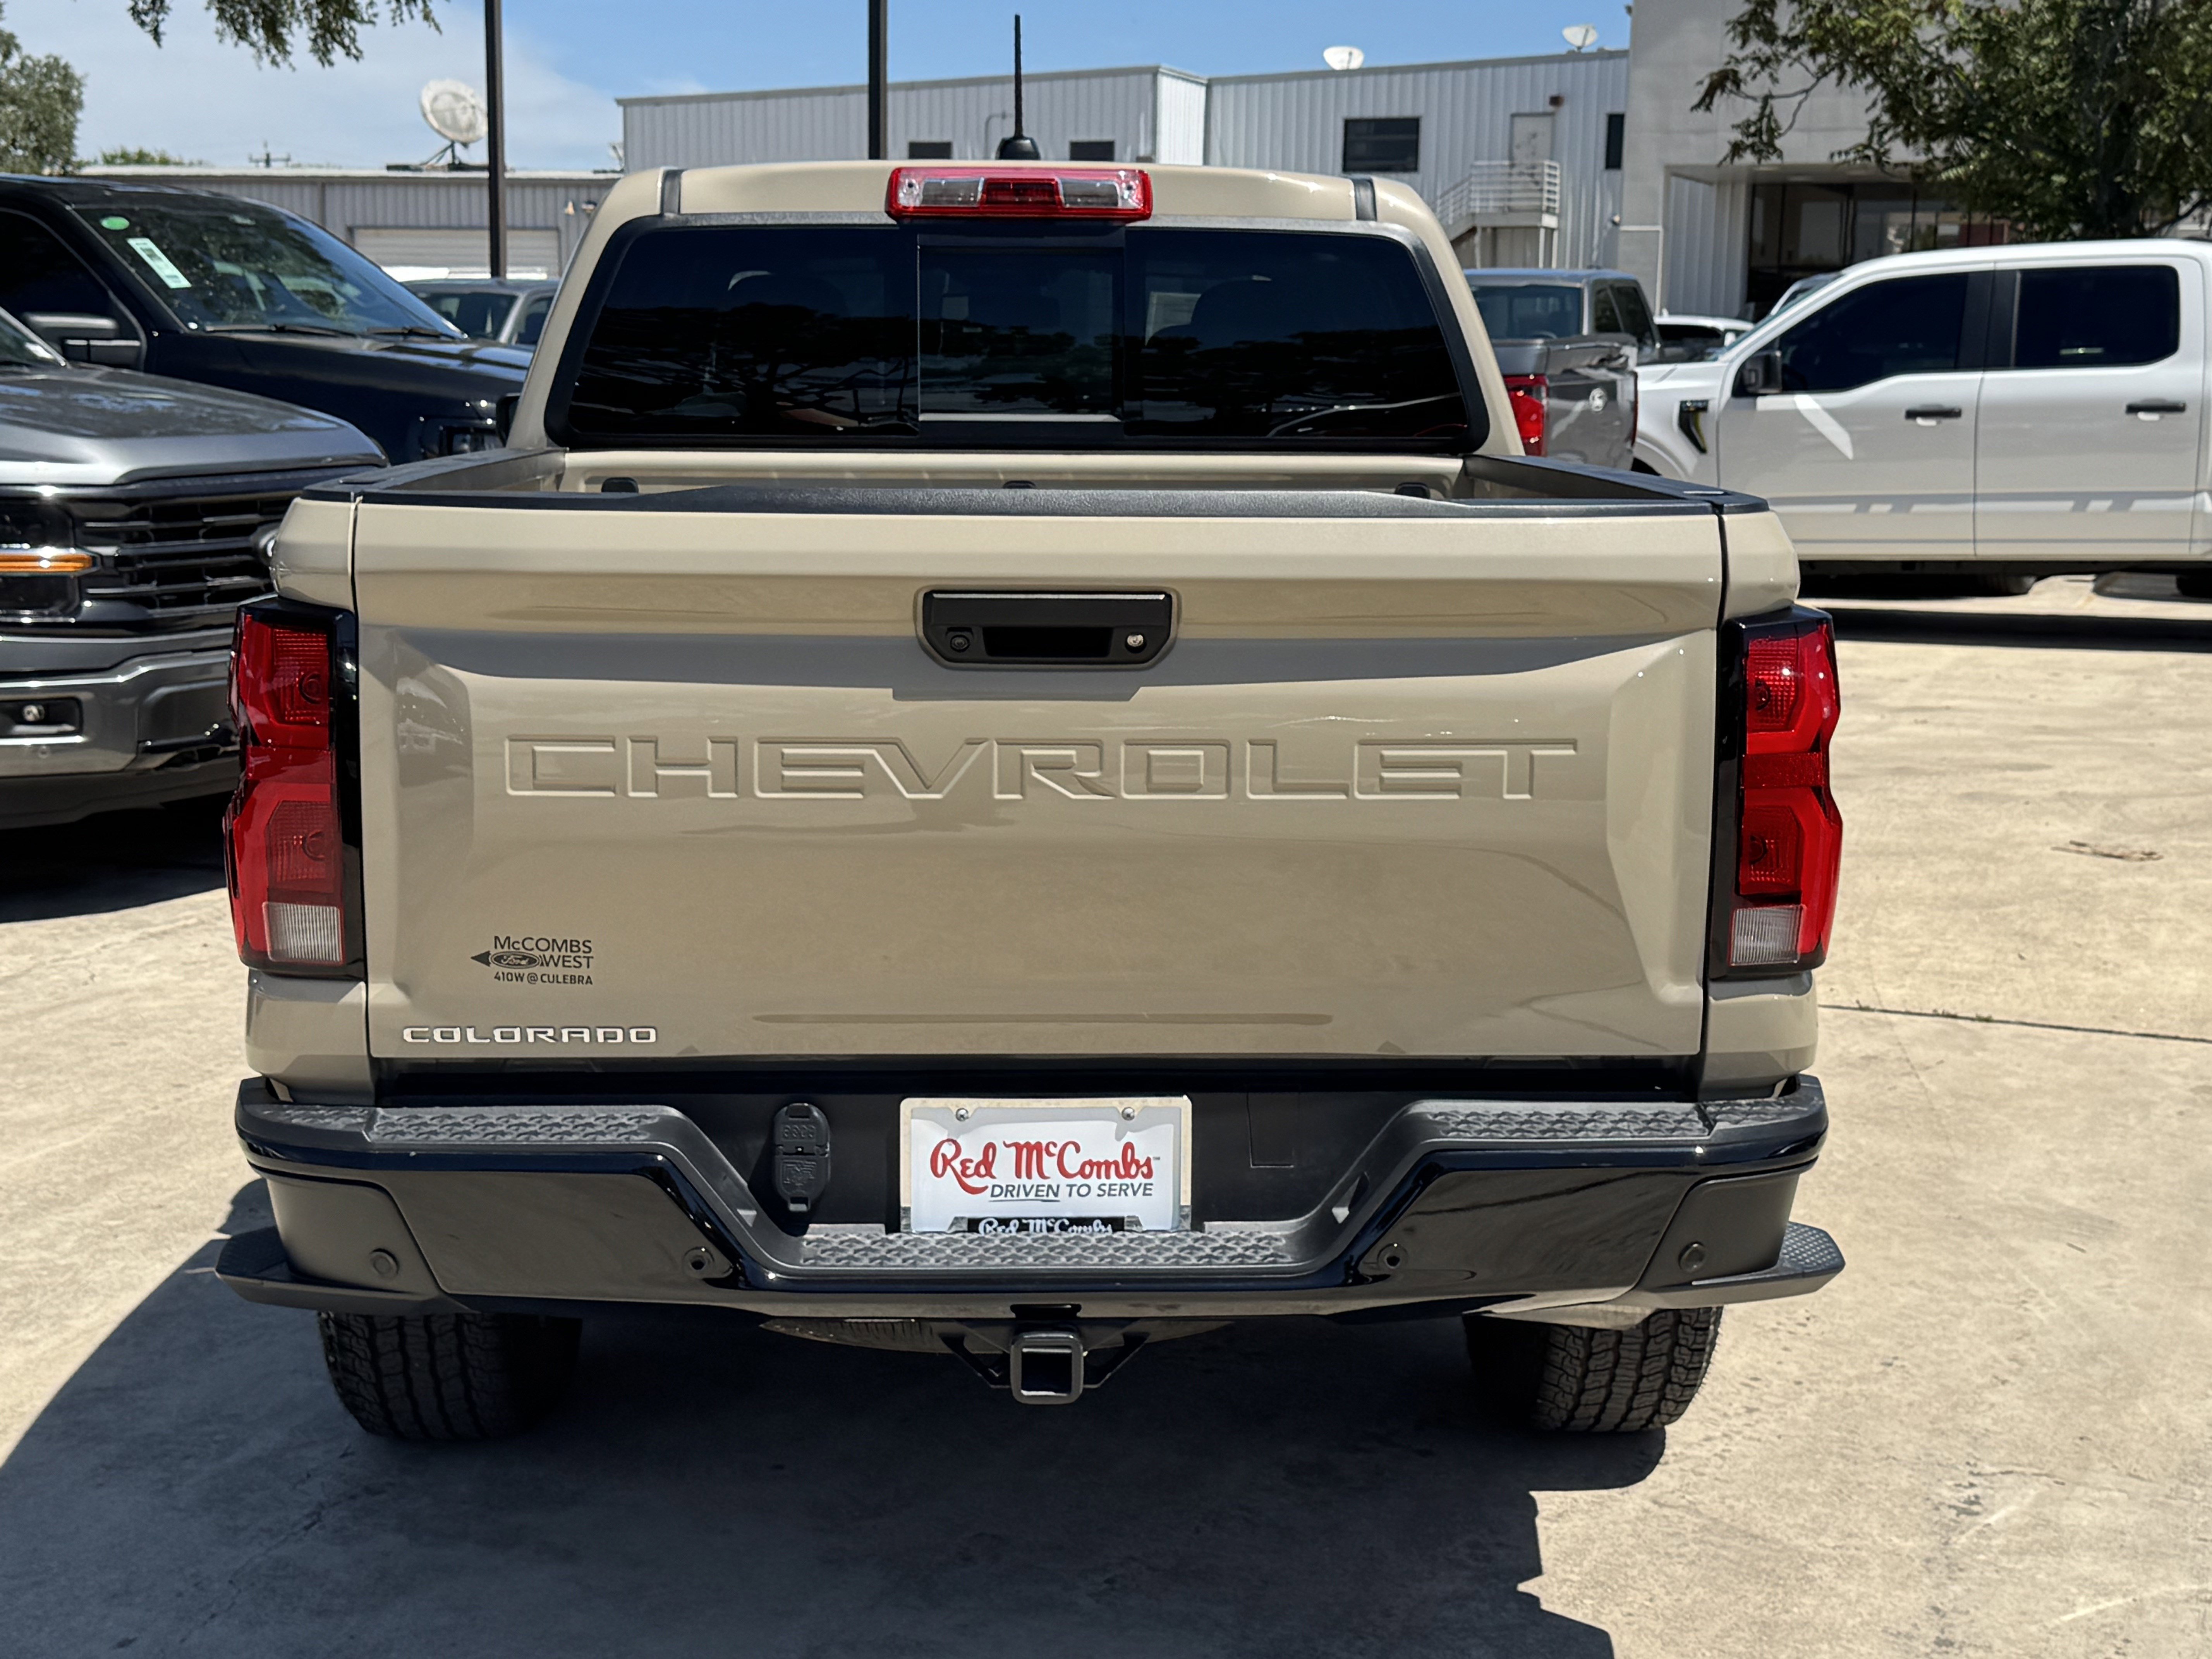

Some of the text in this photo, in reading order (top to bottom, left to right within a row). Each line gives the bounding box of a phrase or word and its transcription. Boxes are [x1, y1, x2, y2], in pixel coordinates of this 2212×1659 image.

[505, 736, 1578, 800] CHEVROLET
[494, 936, 592, 954] McCOMBS
[542, 954, 594, 969] WEST
[403, 1027, 657, 1043] COLORADO
[930, 1138, 1153, 1195] Red McCombs
[990, 1183, 1154, 1198] DRIVEN TO SERVE
